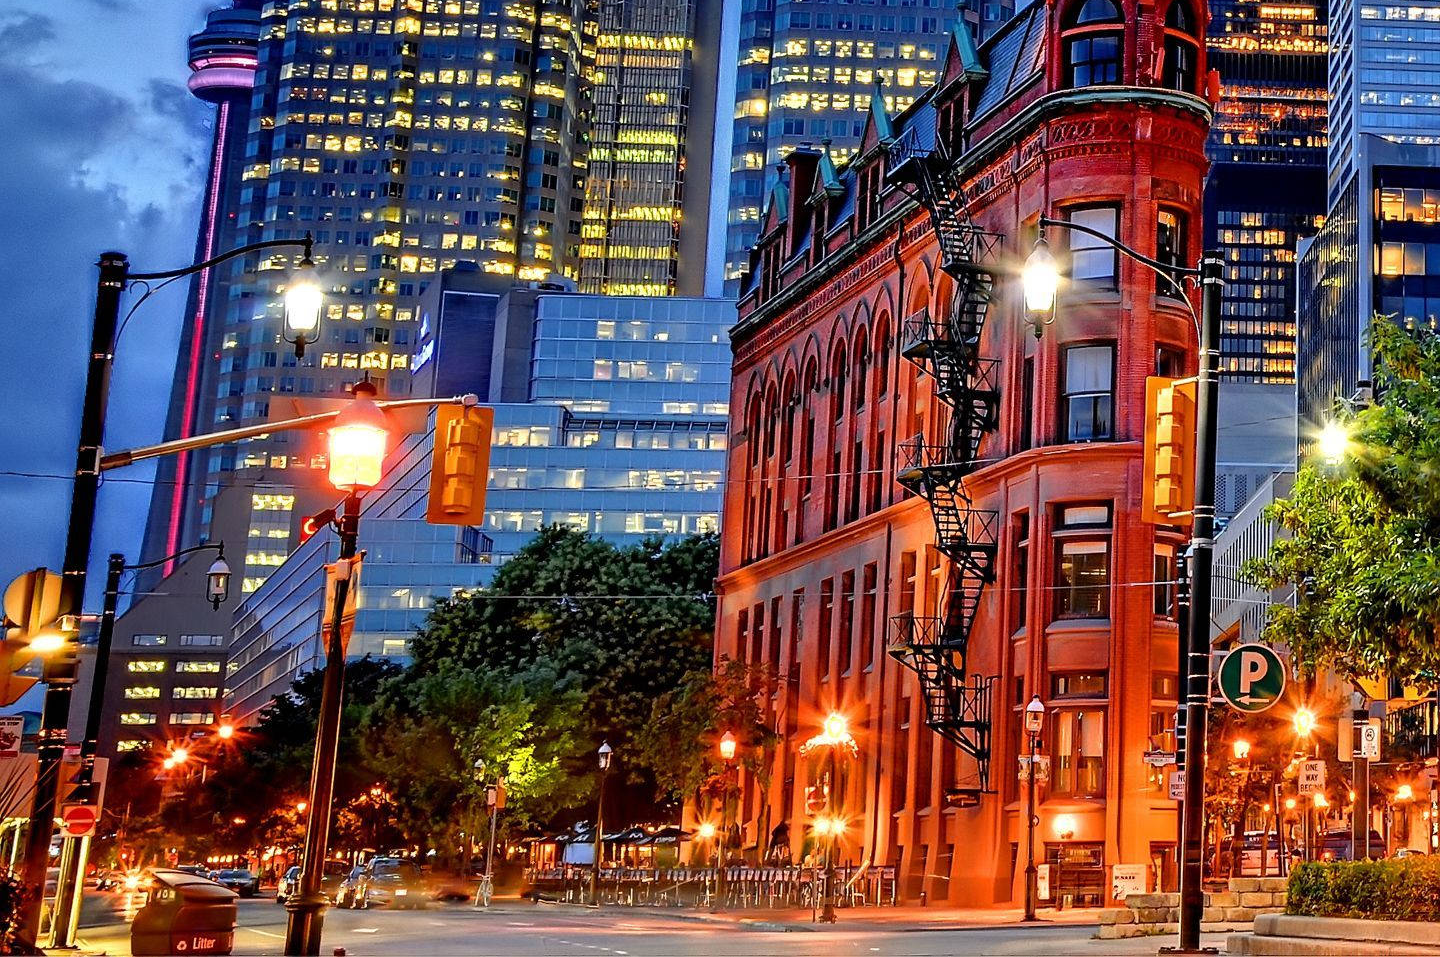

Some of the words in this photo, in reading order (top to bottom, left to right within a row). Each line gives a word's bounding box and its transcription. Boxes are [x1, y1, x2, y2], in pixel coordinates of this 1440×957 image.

[1240, 651, 1268, 694] P
[1305, 763, 1318, 772] ONE
[1305, 774, 1319, 782] WAY
[193, 937, 216, 950] Litter
